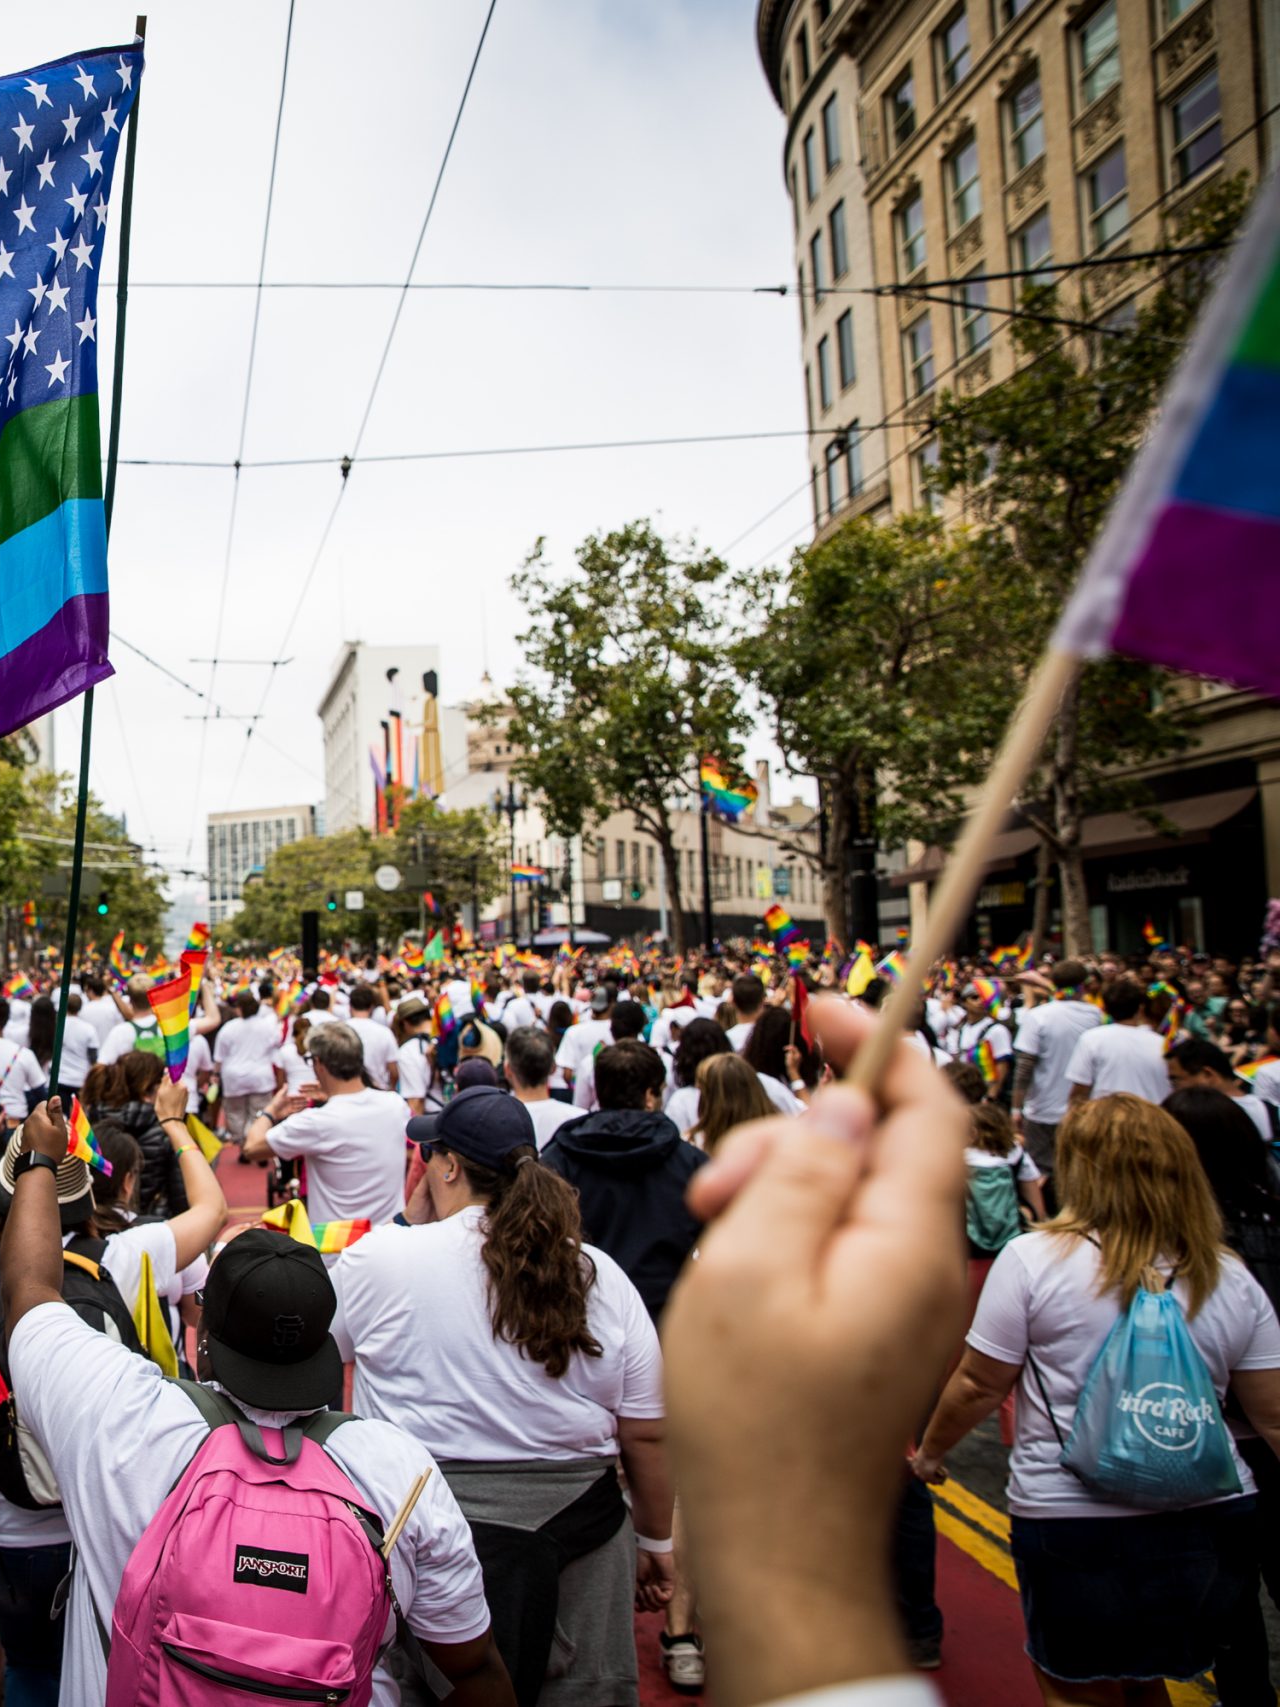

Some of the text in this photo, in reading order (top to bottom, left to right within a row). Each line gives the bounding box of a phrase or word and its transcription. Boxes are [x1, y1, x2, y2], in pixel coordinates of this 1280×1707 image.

[1117, 1390, 1216, 1426] Hard Rock
[1154, 1425, 1185, 1439] CAFE
